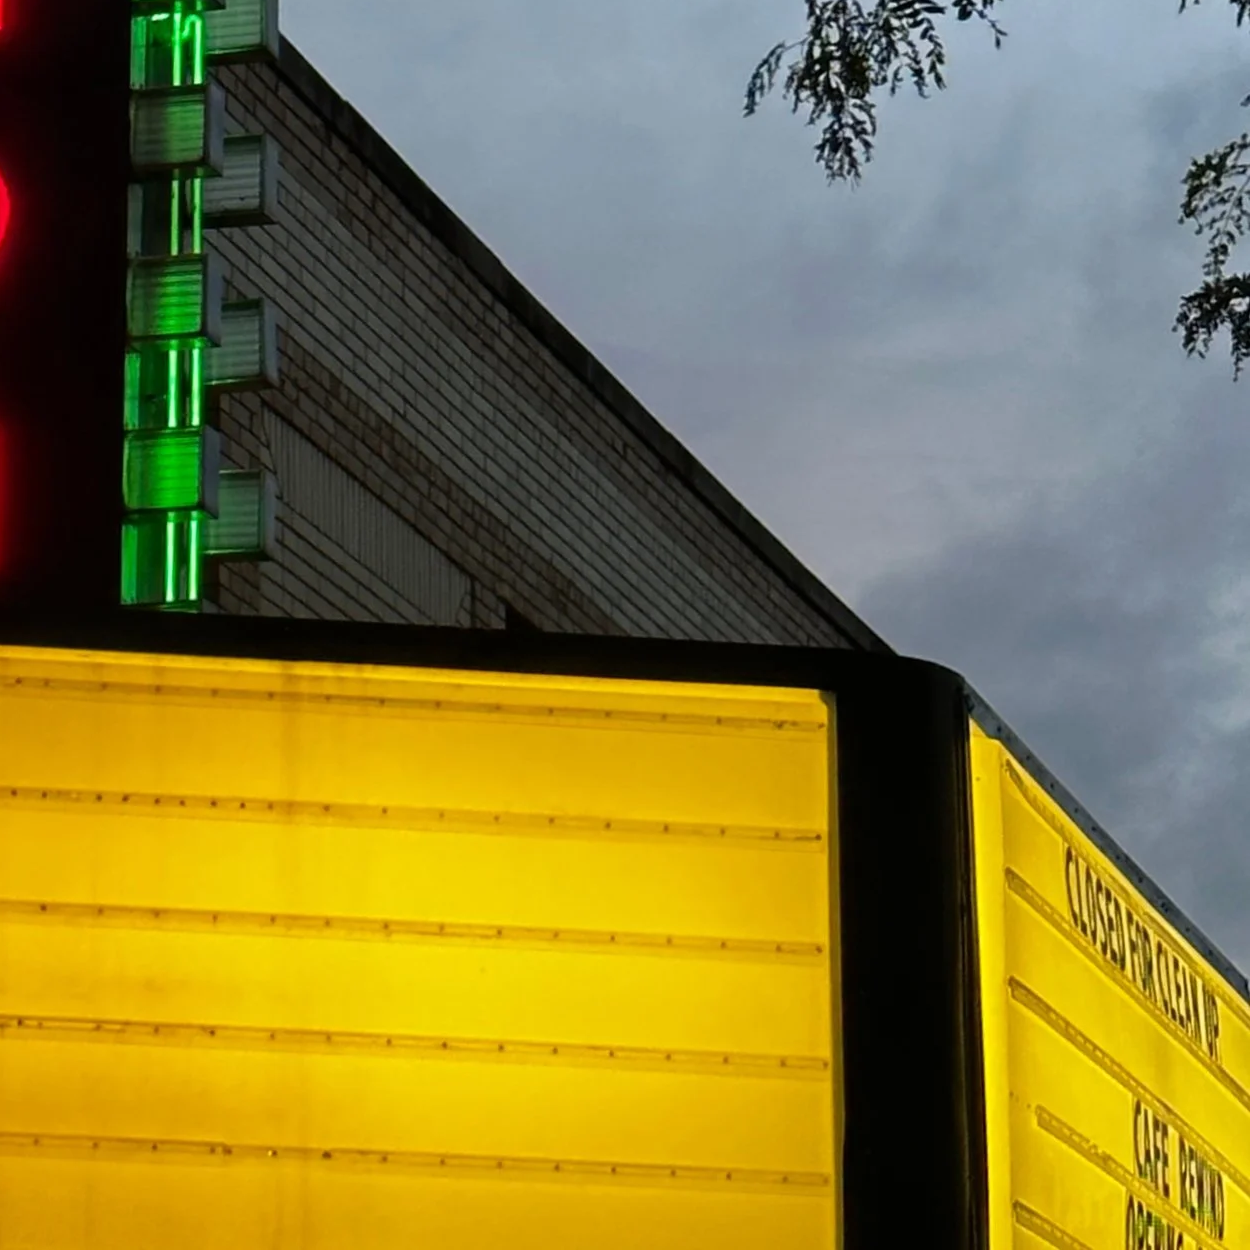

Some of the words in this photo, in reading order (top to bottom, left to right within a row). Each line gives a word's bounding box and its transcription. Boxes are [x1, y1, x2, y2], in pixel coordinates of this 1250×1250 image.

[1065, 845, 1126, 972] CLOSED
[1126, 905, 1158, 1004] FOR
[1156, 939, 1203, 1045] CLEAN
[1202, 978, 1221, 1063] UP
[1134, 1099, 1170, 1199] CAFE
[1179, 1134, 1225, 1242] REWIND
